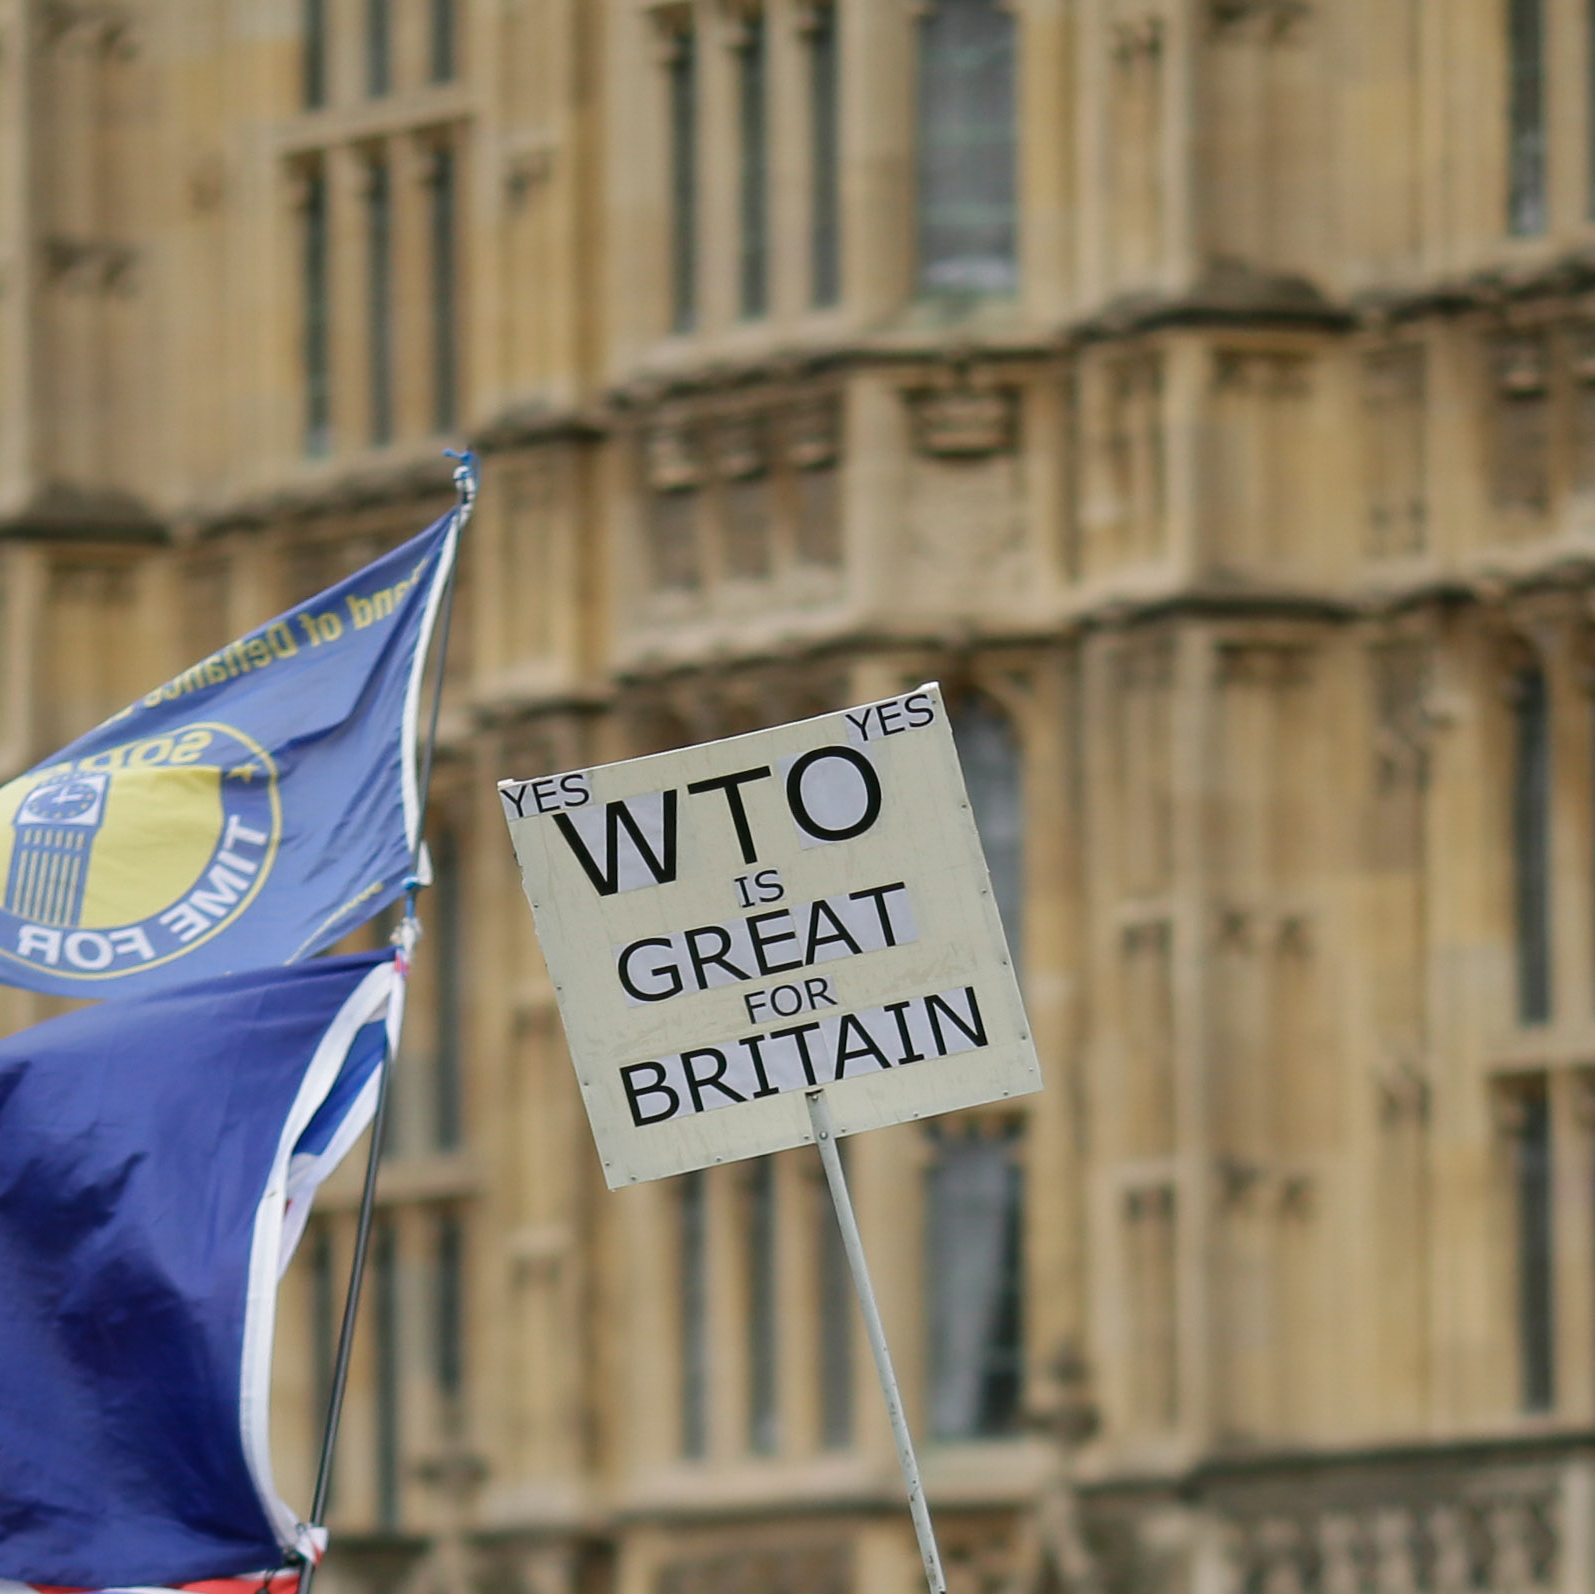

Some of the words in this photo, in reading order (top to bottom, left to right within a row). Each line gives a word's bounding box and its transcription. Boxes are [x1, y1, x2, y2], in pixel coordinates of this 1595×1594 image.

[845, 693, 935, 742] YES
[500, 773, 590, 818] YES
[552, 744, 882, 897] WTO
[734, 868, 785, 909] IS
[617, 881, 906, 1002] GREAT
[743, 976, 838, 1025] FOR
[619, 986, 989, 1127] BRITAIN
